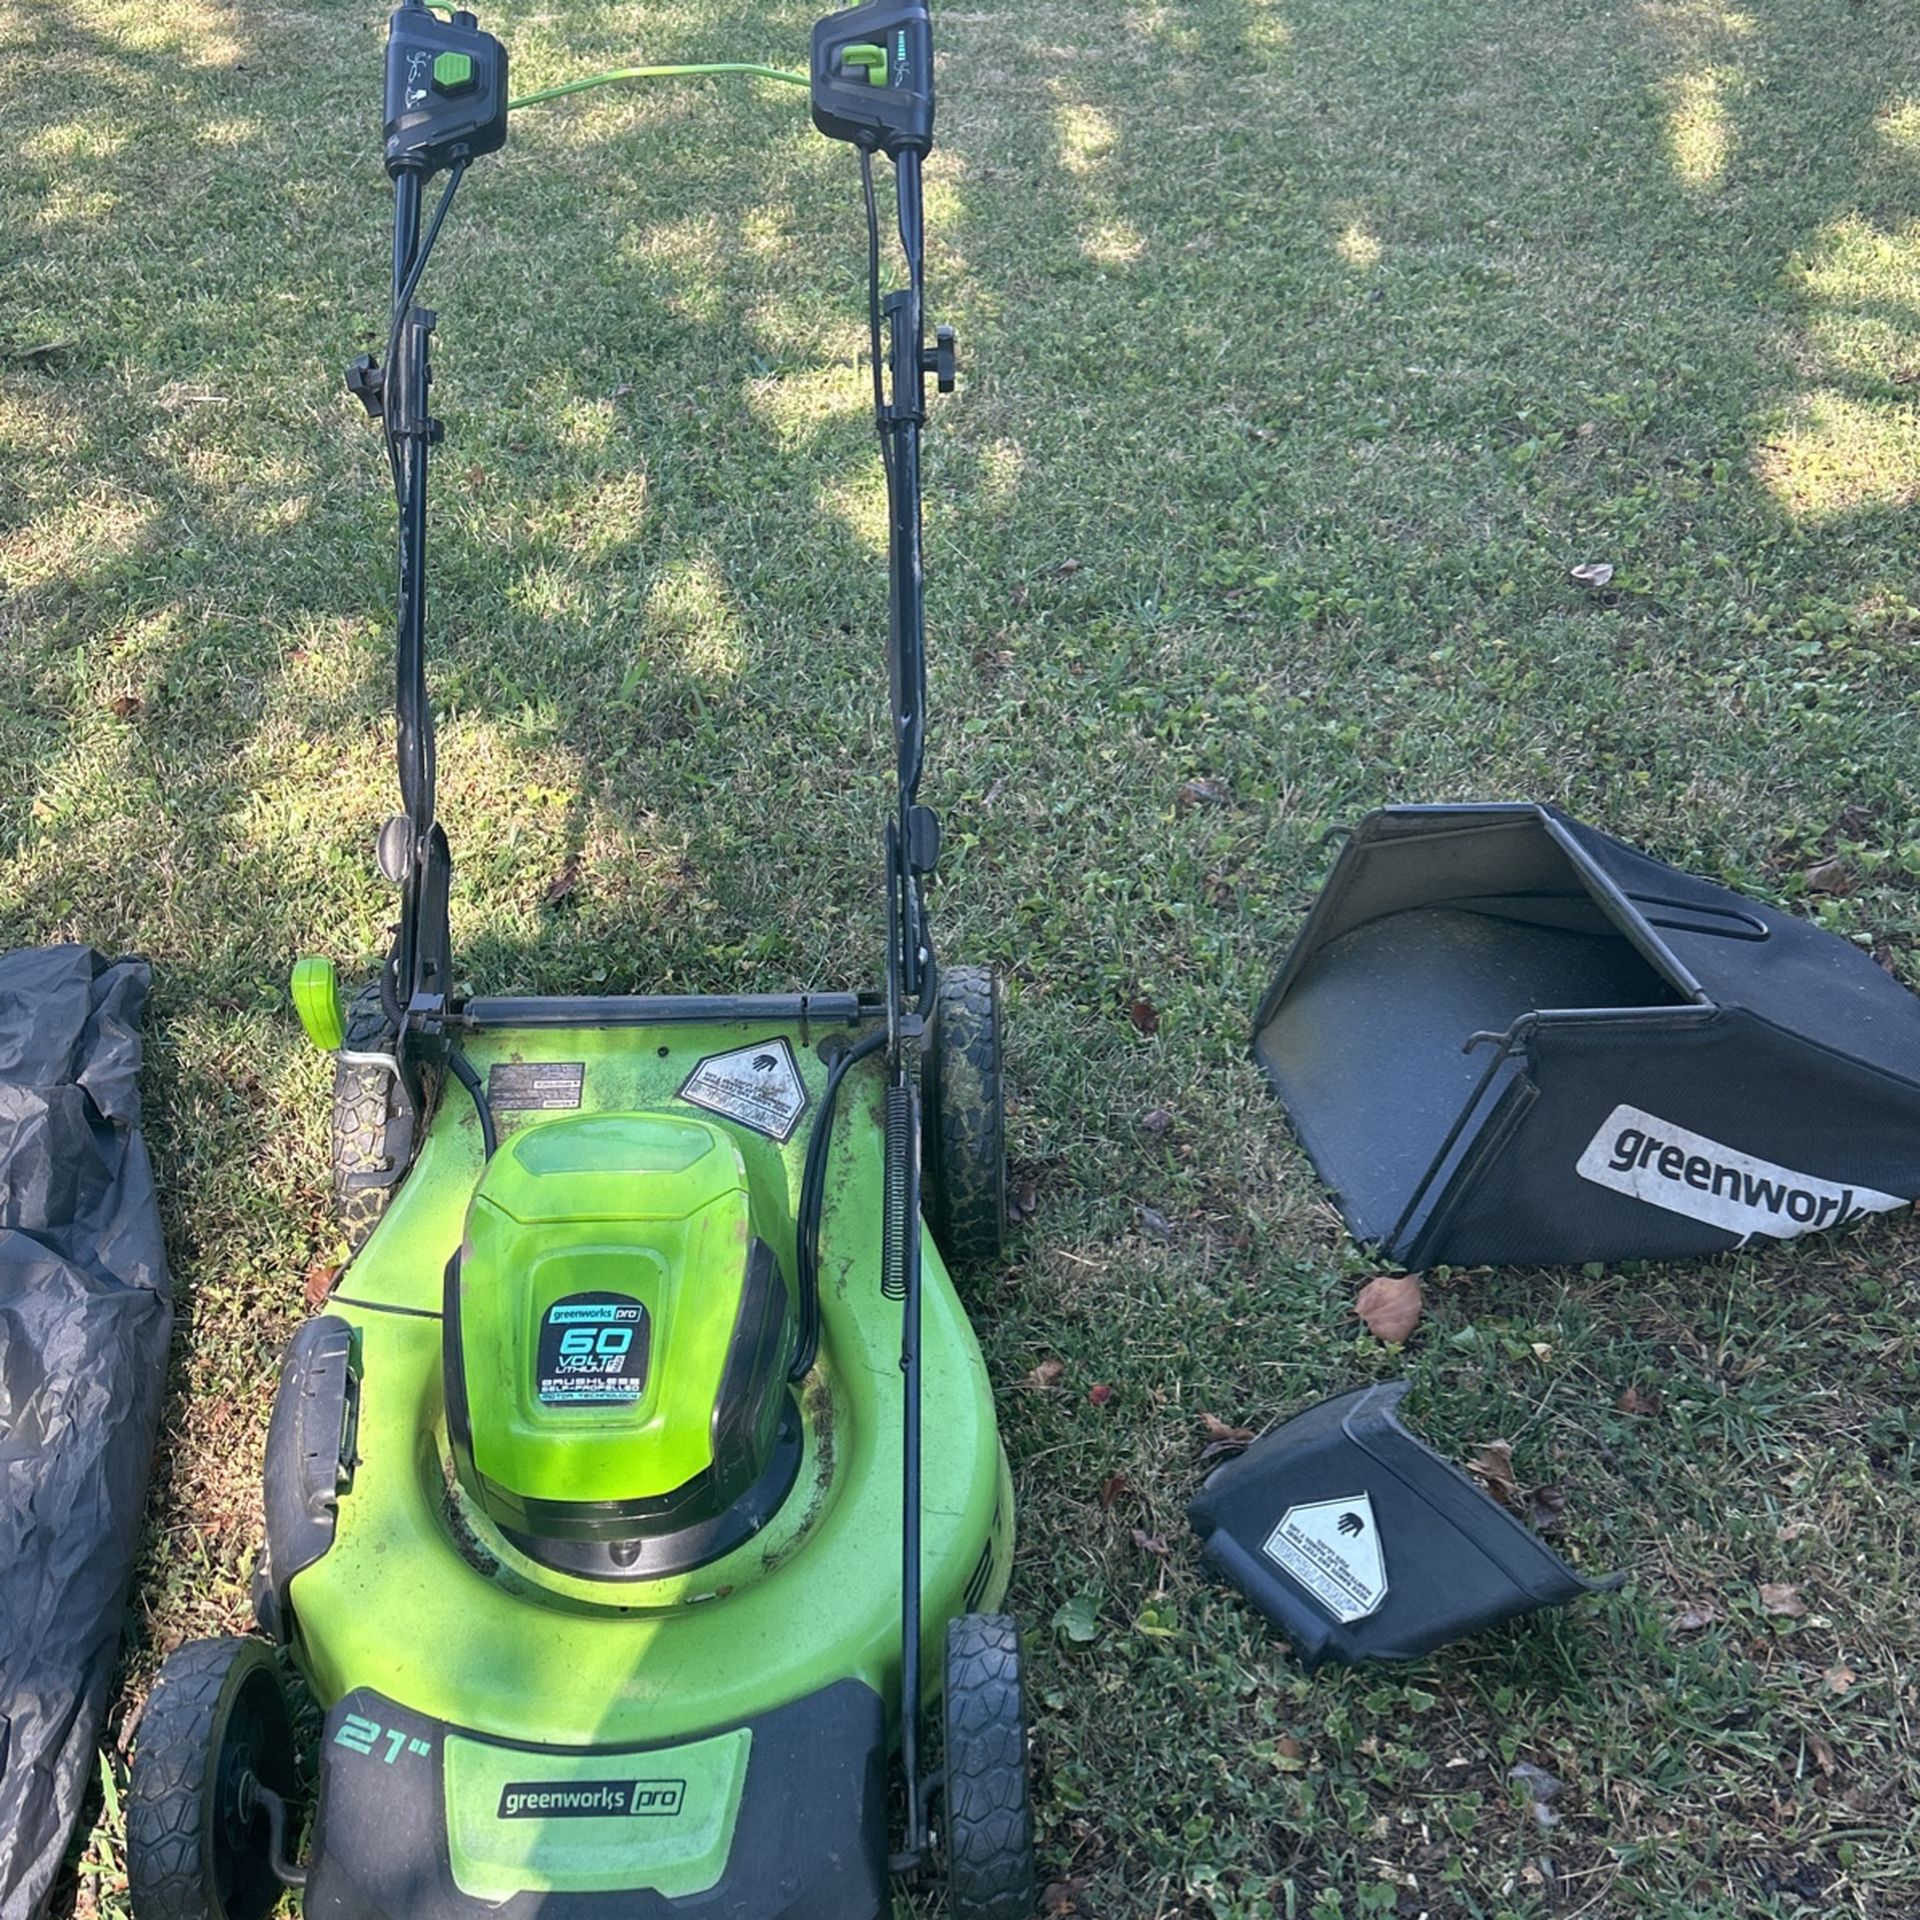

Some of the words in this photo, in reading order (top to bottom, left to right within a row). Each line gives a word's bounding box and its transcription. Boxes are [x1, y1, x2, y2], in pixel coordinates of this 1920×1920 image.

[1609, 1127, 1865, 1227] greenwork
[553, 1308, 611, 1321] greenworks
[615, 1310, 637, 1319] pro
[559, 1328, 633, 1354] 60
[555, 1366, 604, 1374] LITHIUM
[559, 1355, 613, 1366] VOLT
[541, 1377, 640, 1386] BRUSHLESS
[334, 1713, 431, 1765] 21"
[506, 1787, 625, 1814] greenworks
[636, 1791, 677, 1811] pro
